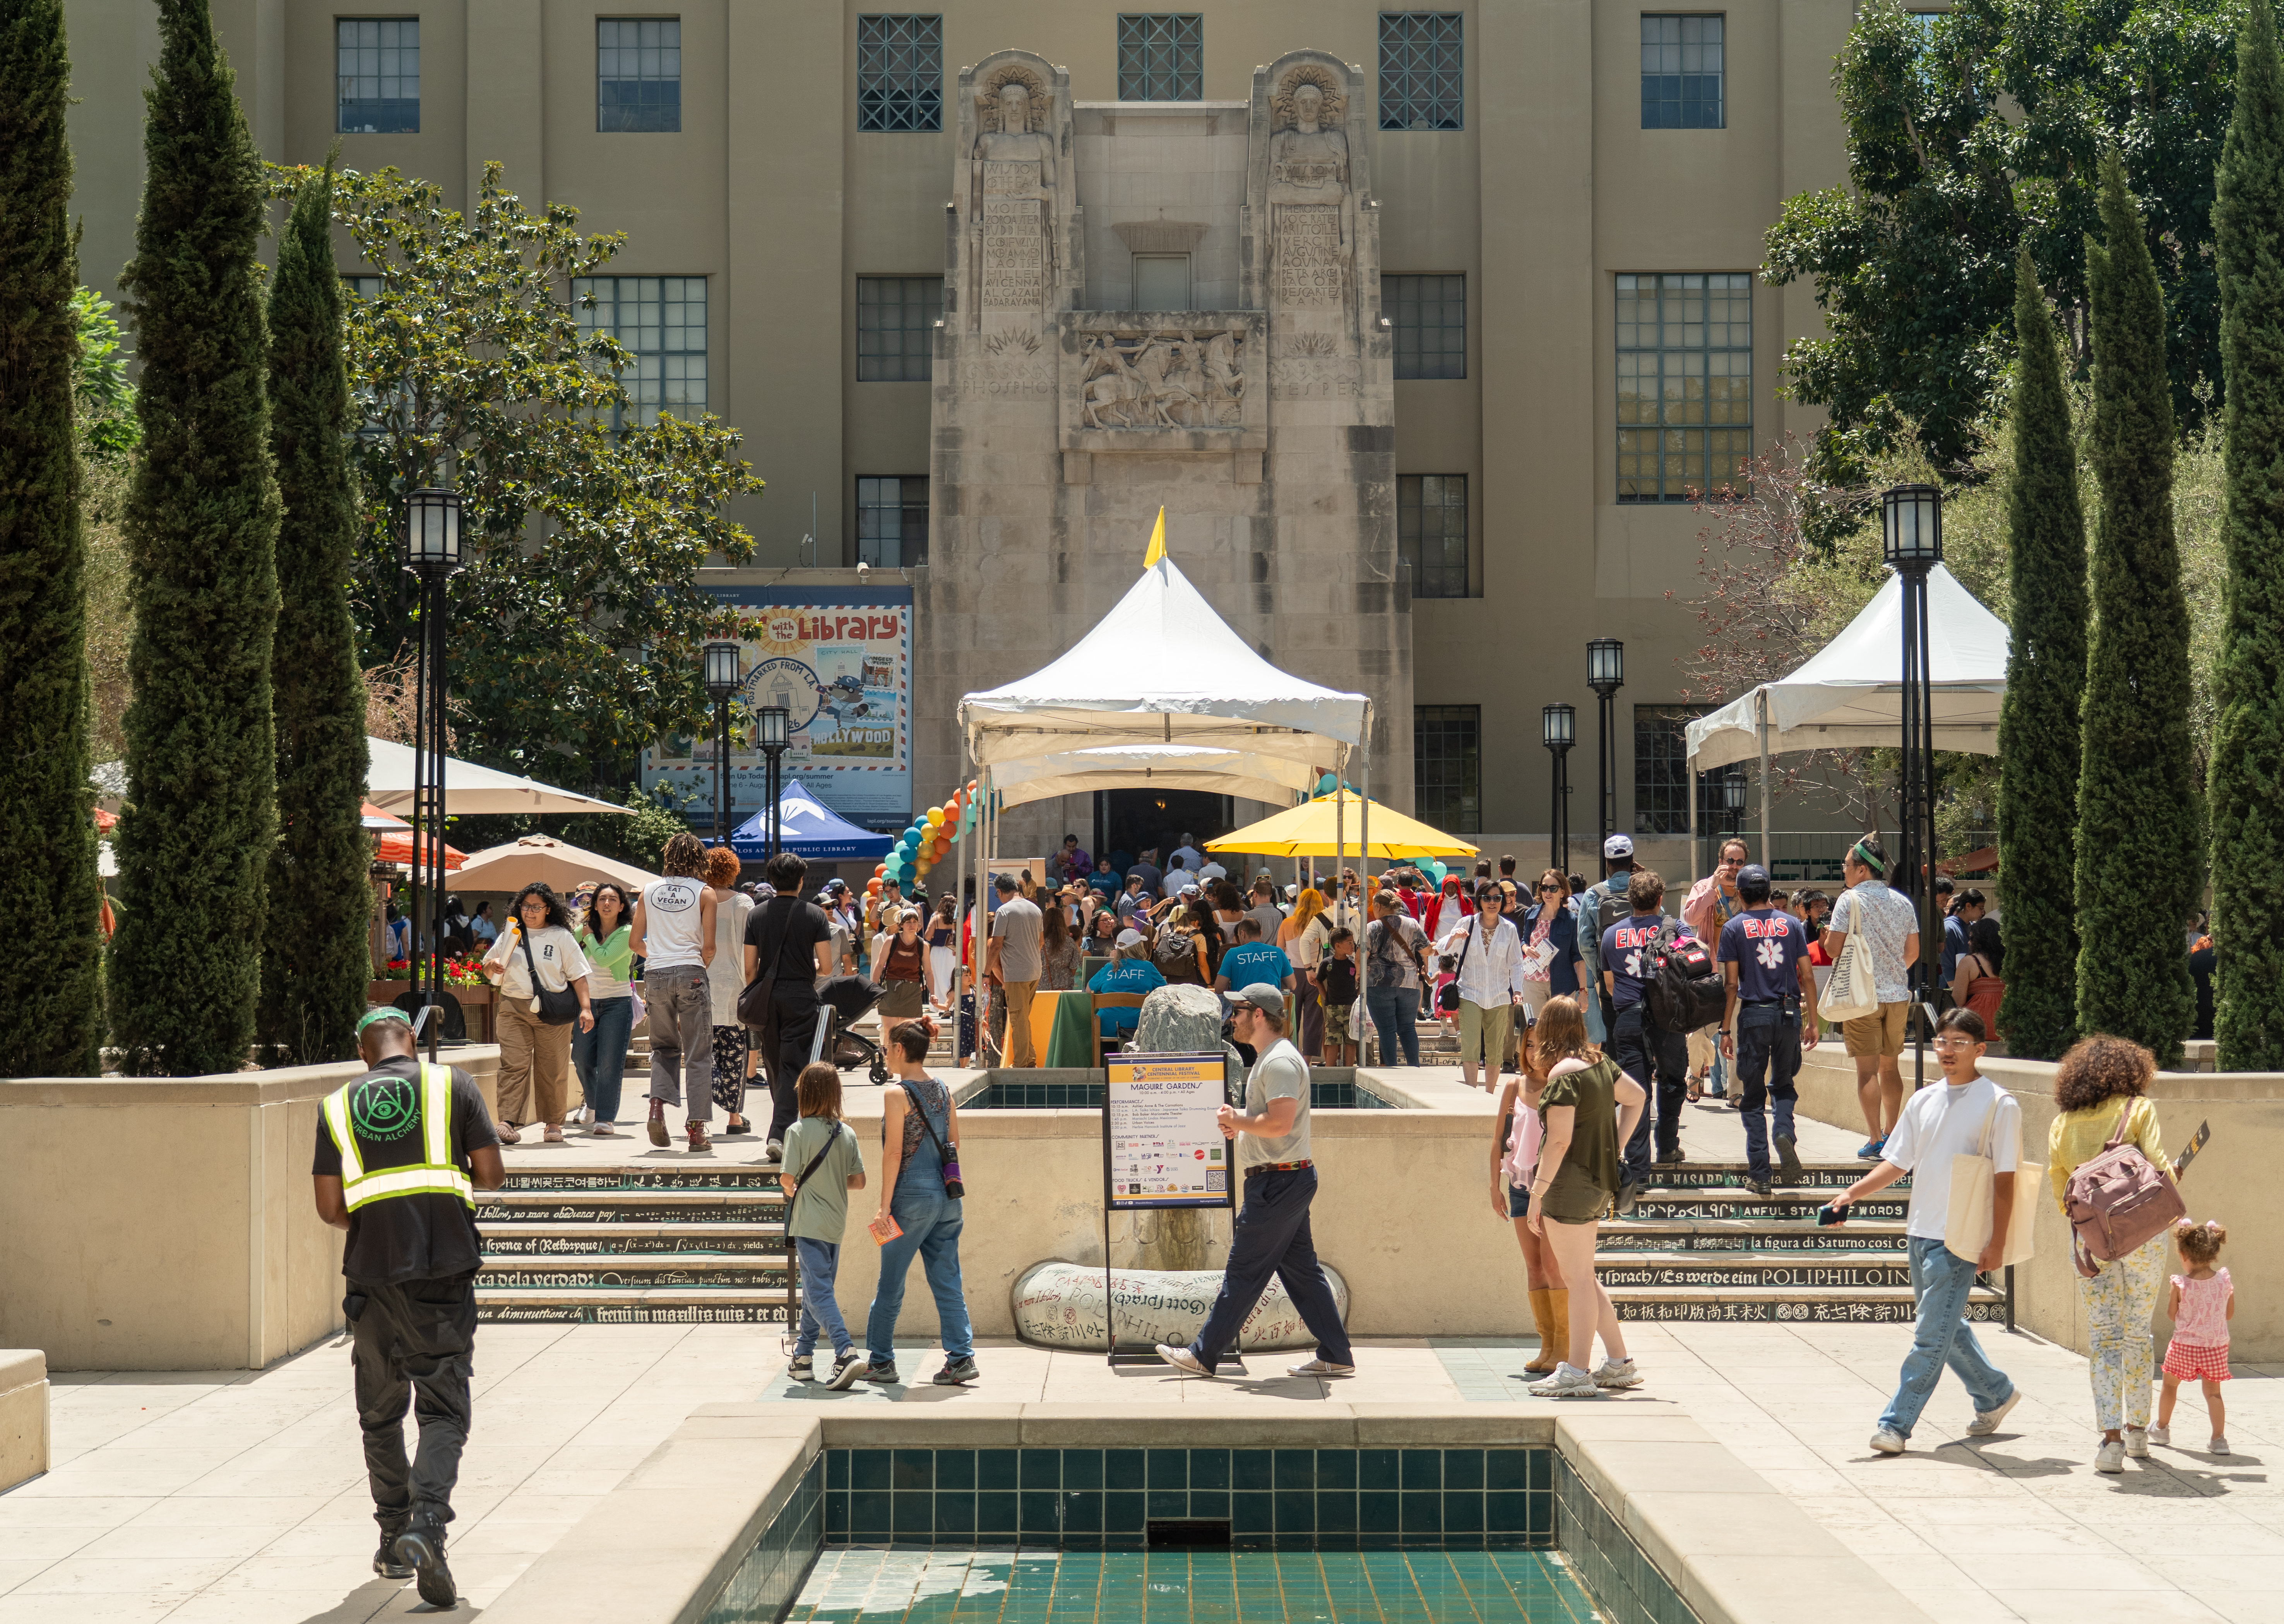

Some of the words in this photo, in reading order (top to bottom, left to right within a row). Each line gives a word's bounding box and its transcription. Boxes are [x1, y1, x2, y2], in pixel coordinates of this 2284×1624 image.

[985, 164, 1039, 174] WISDOM
[1284, 166, 1334, 175] WISDOM
[1016, 177, 1039, 188] EAST
[1305, 176, 1327, 184] WEST
[988, 204, 1038, 213] MOSES
[986, 216, 1039, 224] ZOROASTER
[1283, 214, 1336, 224] SOCRATES
[985, 226, 1037, 235] BUDDHA
[1282, 224, 1337, 235] ARISTOTLE
[1283, 236, 1337, 246] VERGIL
[1283, 247, 1338, 257] AUGUSTINE
[987, 259, 1015, 268] LAO
[1020, 259, 1039, 268] TSE
[1282, 257, 1337, 267] AQUINAS
[987, 270, 1039, 278] HILLEL
[1282, 269, 1337, 279] PETRARCH
[985, 279, 1040, 287] AVICENNA
[1282, 276, 1337, 286] BACON
[984, 288, 998, 297] AL
[1282, 287, 1341, 297] DESCARTES
[983, 298, 1040, 307] BADARAYANA
[1282, 297, 1338, 305] KANT
[963, 380, 1059, 394] PHOSPHOR
[1270, 382, 1360, 395] HESPER
[772, 622, 794, 630] with
[798, 615, 898, 641] Library
[775, 631, 793, 639] the
[749, 663, 777, 705] POSTMARKED
[781, 661, 804, 675] FROM
[812, 729, 891, 745] HOLLYWOOD
[1742, 918, 1789, 939] EMS
[1615, 925, 1659, 949] EMS
[1237, 951, 1277, 964] STAFF
[1693, 951, 1704, 961] EMS
[1106, 969, 1145, 981] STAFF
[1820, 1172, 1833, 1184] la
[553, 1206, 595, 1219] obedience
[596, 1210, 615, 1222] pay
[1744, 1207, 1785, 1216] AWFUL
[1859, 1206, 1903, 1215] WORDS
[743, 1241, 764, 1250] yields
[1751, 1236, 1761, 1248] la
[1765, 1235, 1801, 1252] figura
[1803, 1236, 1814, 1248] di
[1818, 1236, 1866, 1248] Saturno
[1868, 1236, 1893, 1249] così
[1762, 1269, 1883, 1285] POLIPHILO
